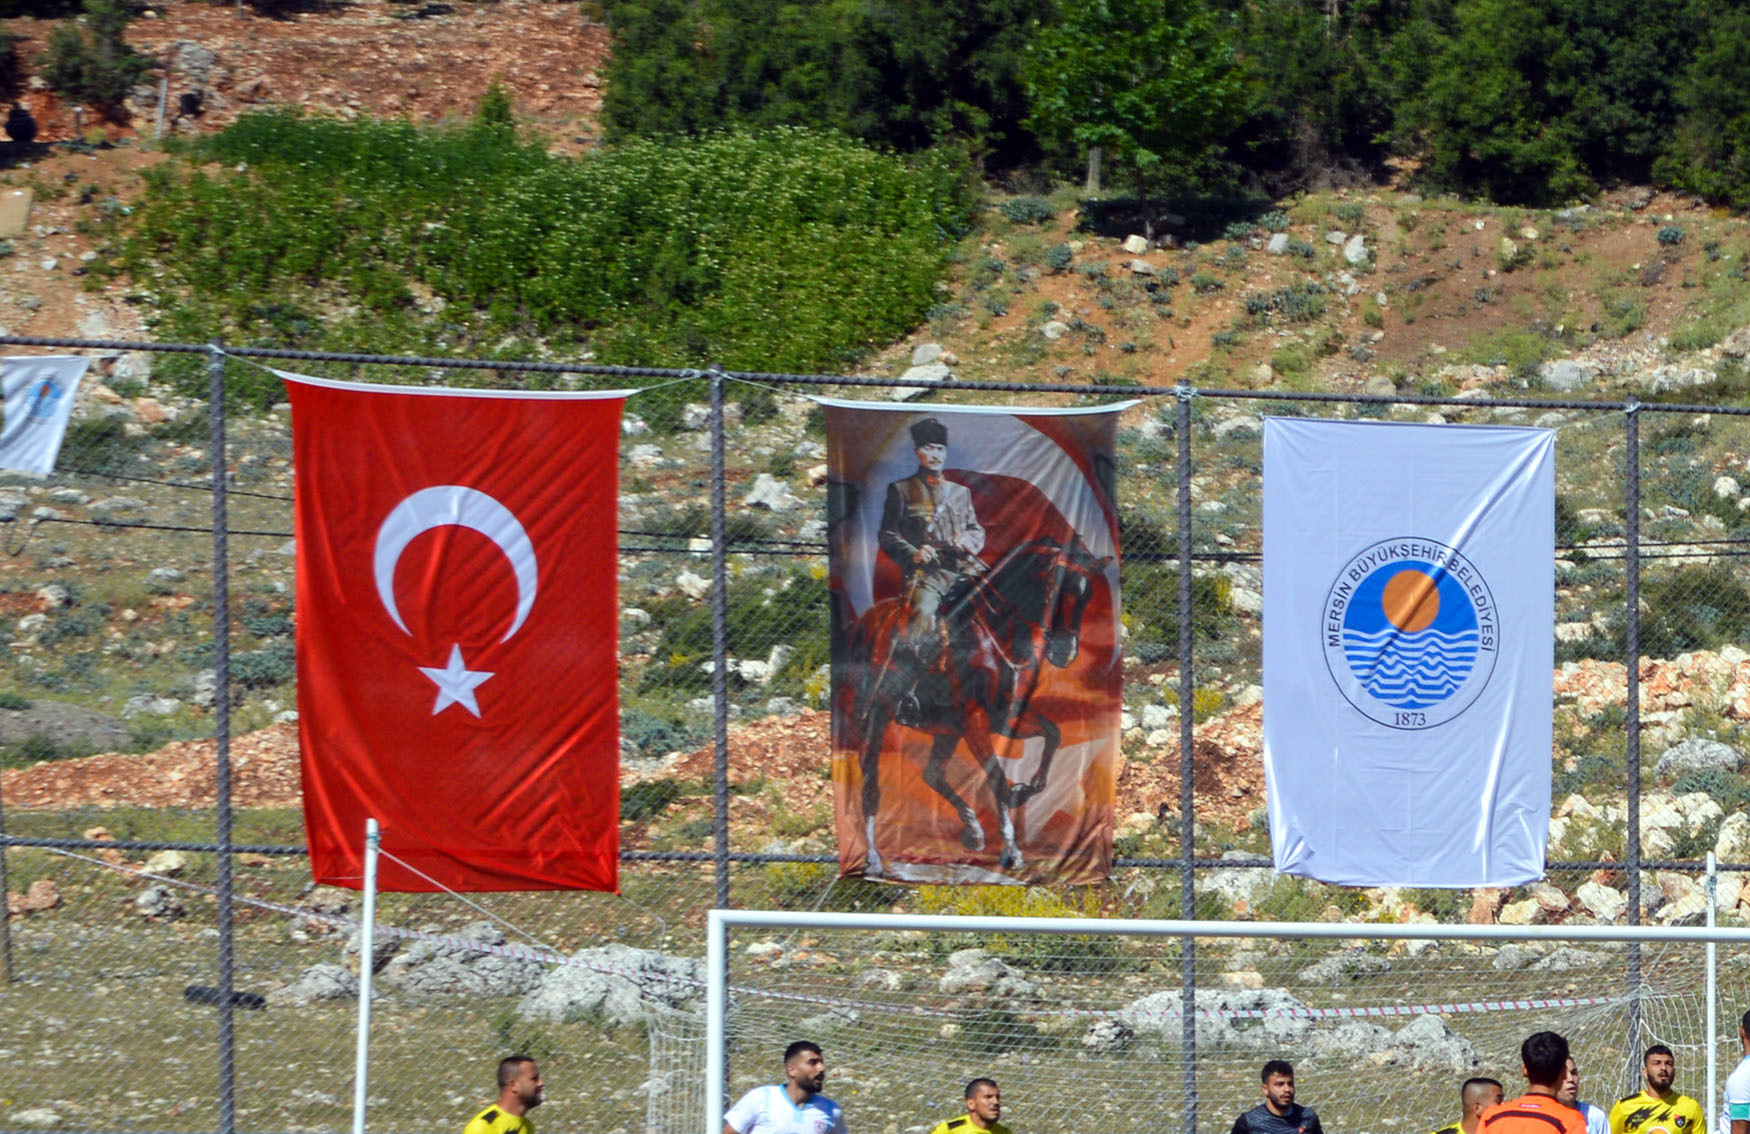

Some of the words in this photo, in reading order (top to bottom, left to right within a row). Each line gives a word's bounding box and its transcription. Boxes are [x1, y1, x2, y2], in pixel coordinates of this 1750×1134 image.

[1328, 581, 1352, 648] MERSİN
[1349, 544, 1448, 582] BÜYÜKŞEHİR
[1447, 558, 1496, 652] BELEDİYESİ
[1394, 712, 1426, 727] 1873
